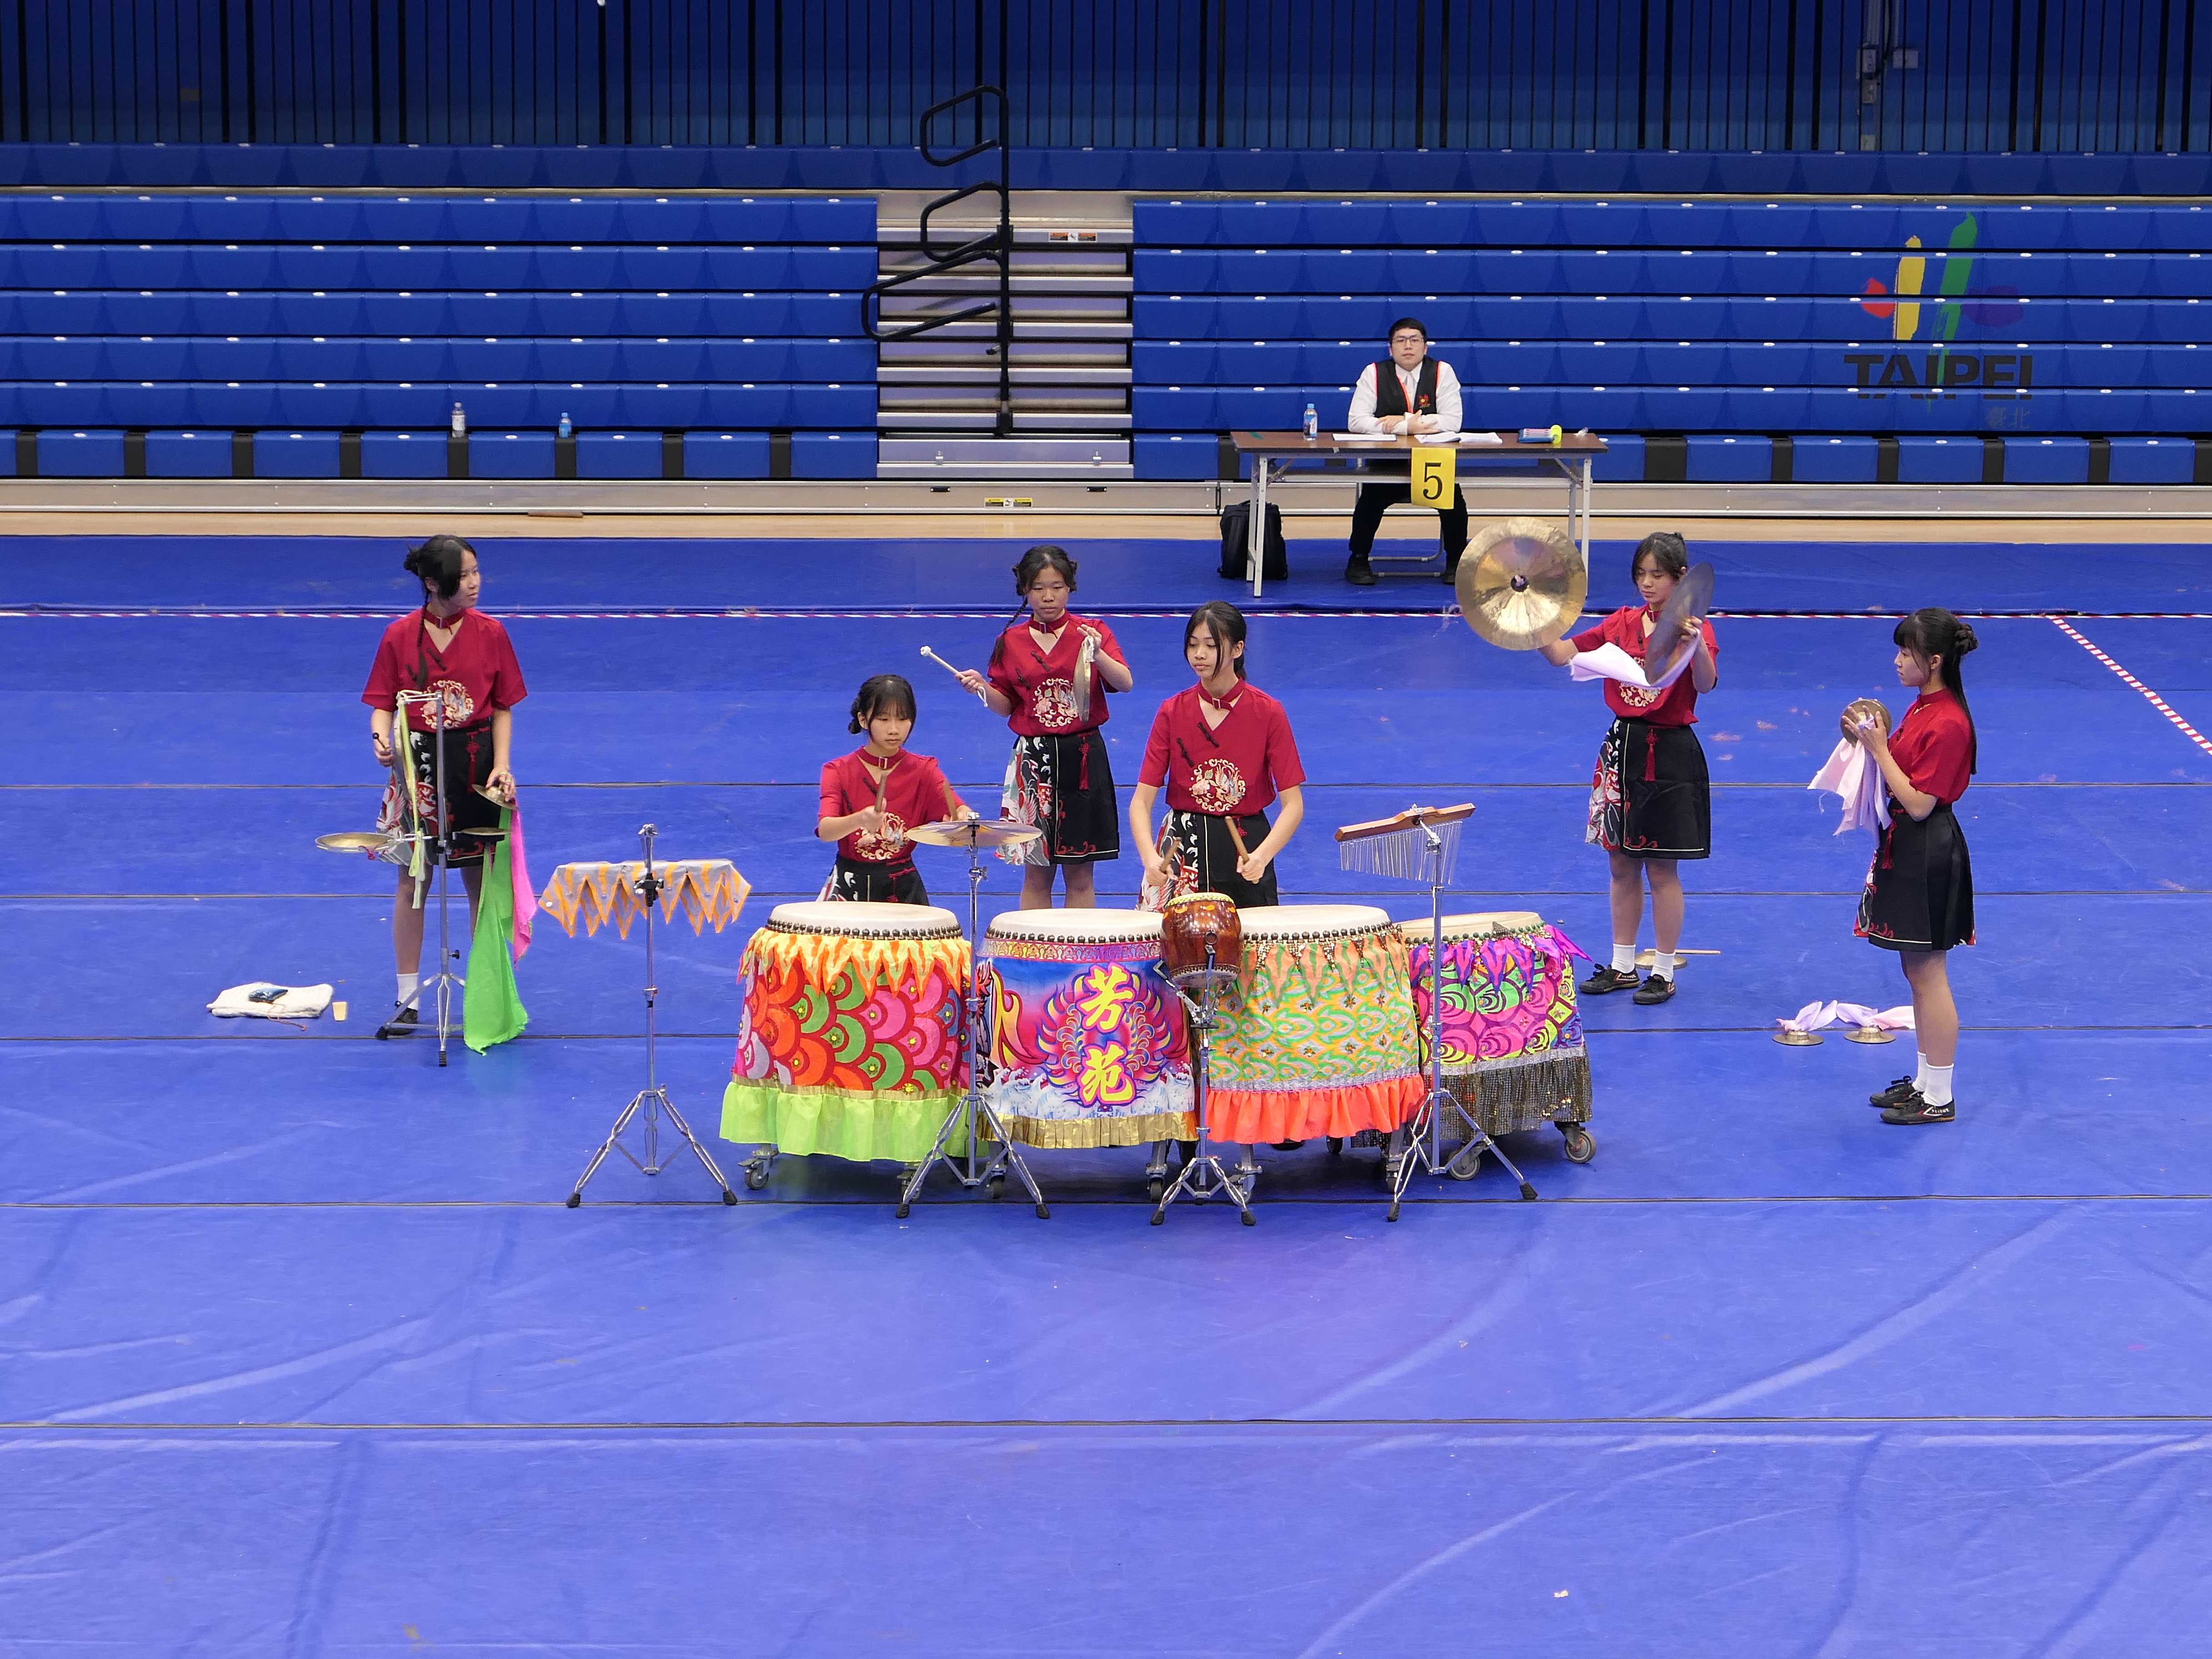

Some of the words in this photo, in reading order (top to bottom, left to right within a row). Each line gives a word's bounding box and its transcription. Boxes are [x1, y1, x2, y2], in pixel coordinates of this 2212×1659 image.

[1844, 355, 2033, 399] TAIPEI
[1423, 462, 1443, 500] 5
[1077, 964, 1136, 1104] 芳苑
